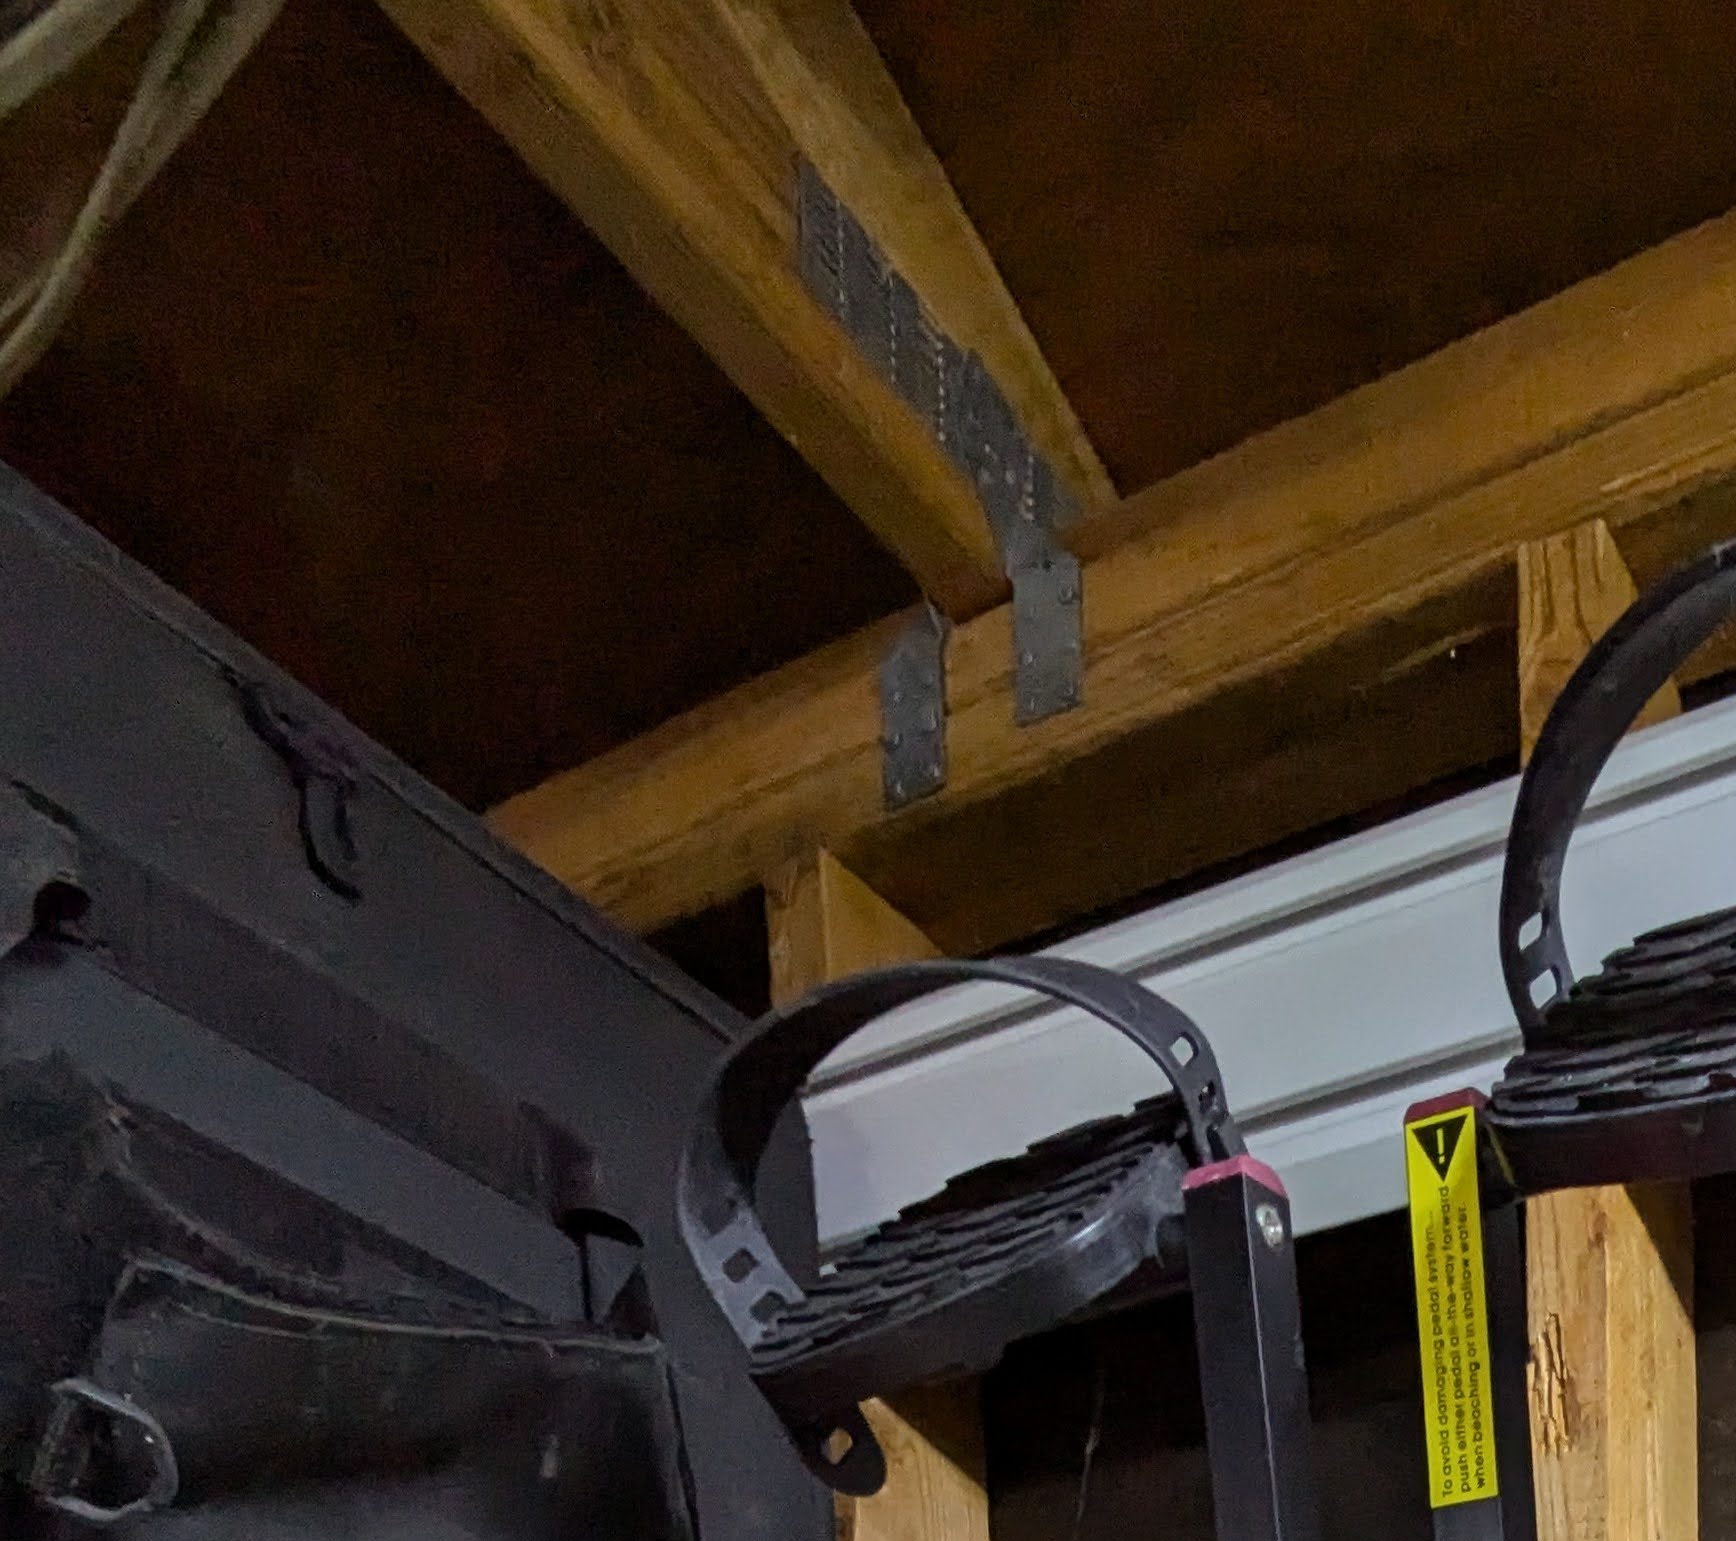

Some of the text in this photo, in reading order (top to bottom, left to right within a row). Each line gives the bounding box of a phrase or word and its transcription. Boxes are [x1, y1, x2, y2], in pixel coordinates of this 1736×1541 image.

[1439, 1187, 1452, 1250] forward
[1428, 1286, 1443, 1336] pedal
[1461, 1258, 1474, 1319] shallow
[1468, 1341, 1476, 1357] or
[1433, 1338, 1448, 1425] damaging
[1450, 1351, 1465, 1399] pedal
[1469, 1362, 1482, 1442] beaching
[1455, 1404, 1468, 1450] either
[1439, 1429, 1451, 1476] avoid
[1457, 1454, 1471, 1493] push
[1474, 1445, 1486, 1488] when
[1442, 1479, 1453, 1497] To
